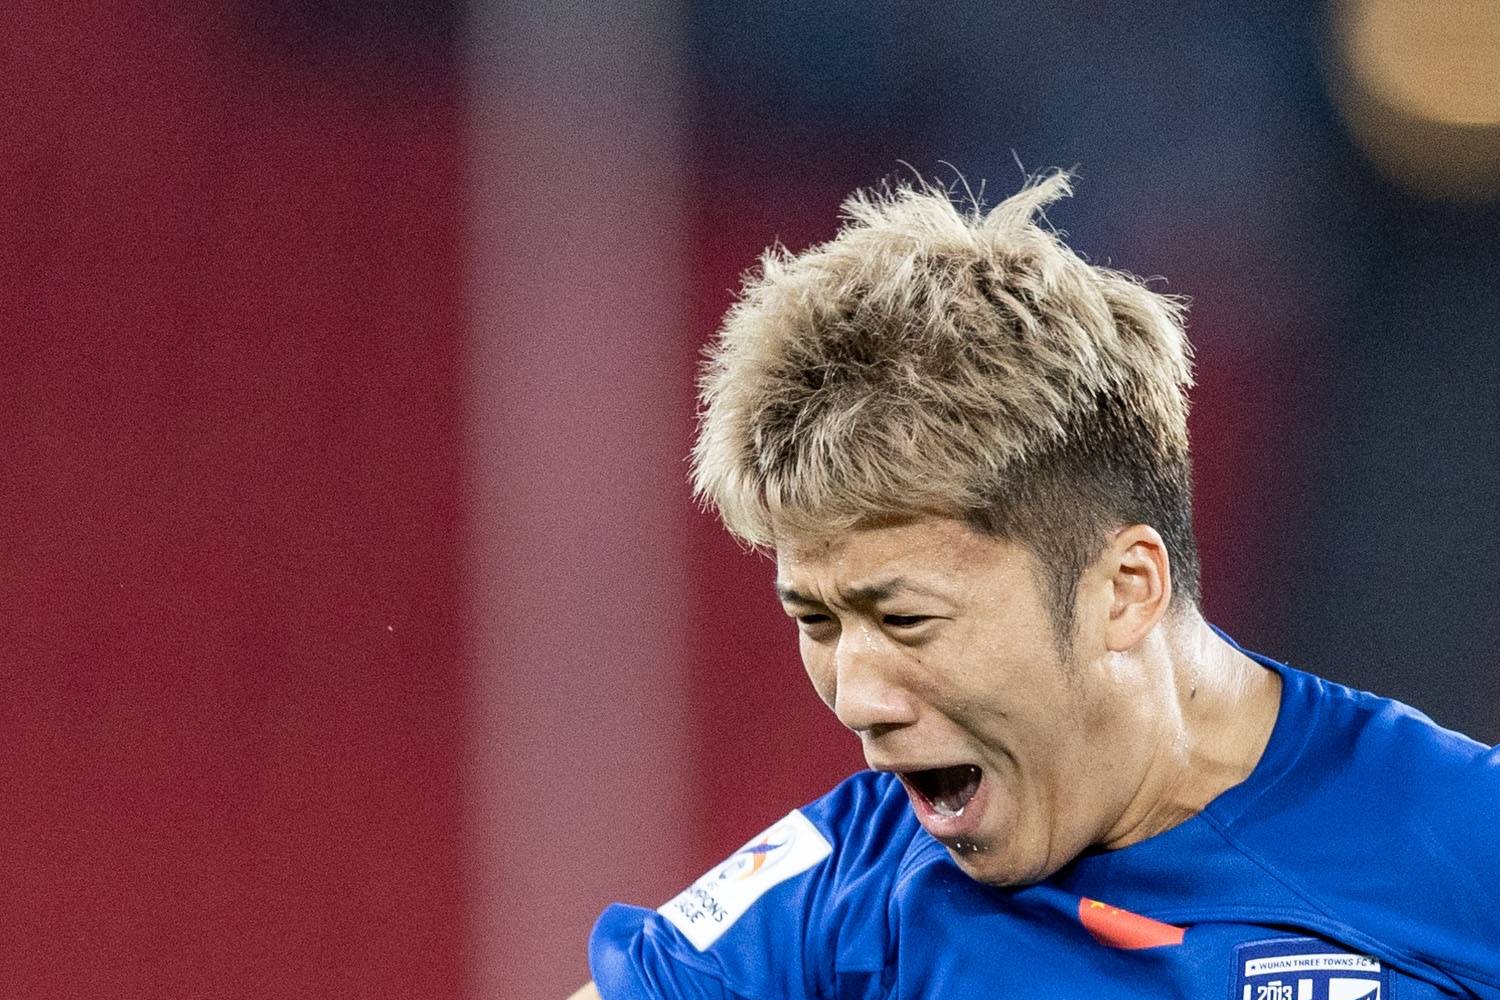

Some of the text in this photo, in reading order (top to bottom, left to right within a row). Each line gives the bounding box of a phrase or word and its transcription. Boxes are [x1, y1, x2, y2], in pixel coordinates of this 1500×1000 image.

[1259, 957, 1368, 970] WUHAN THREE TOWNS FC
